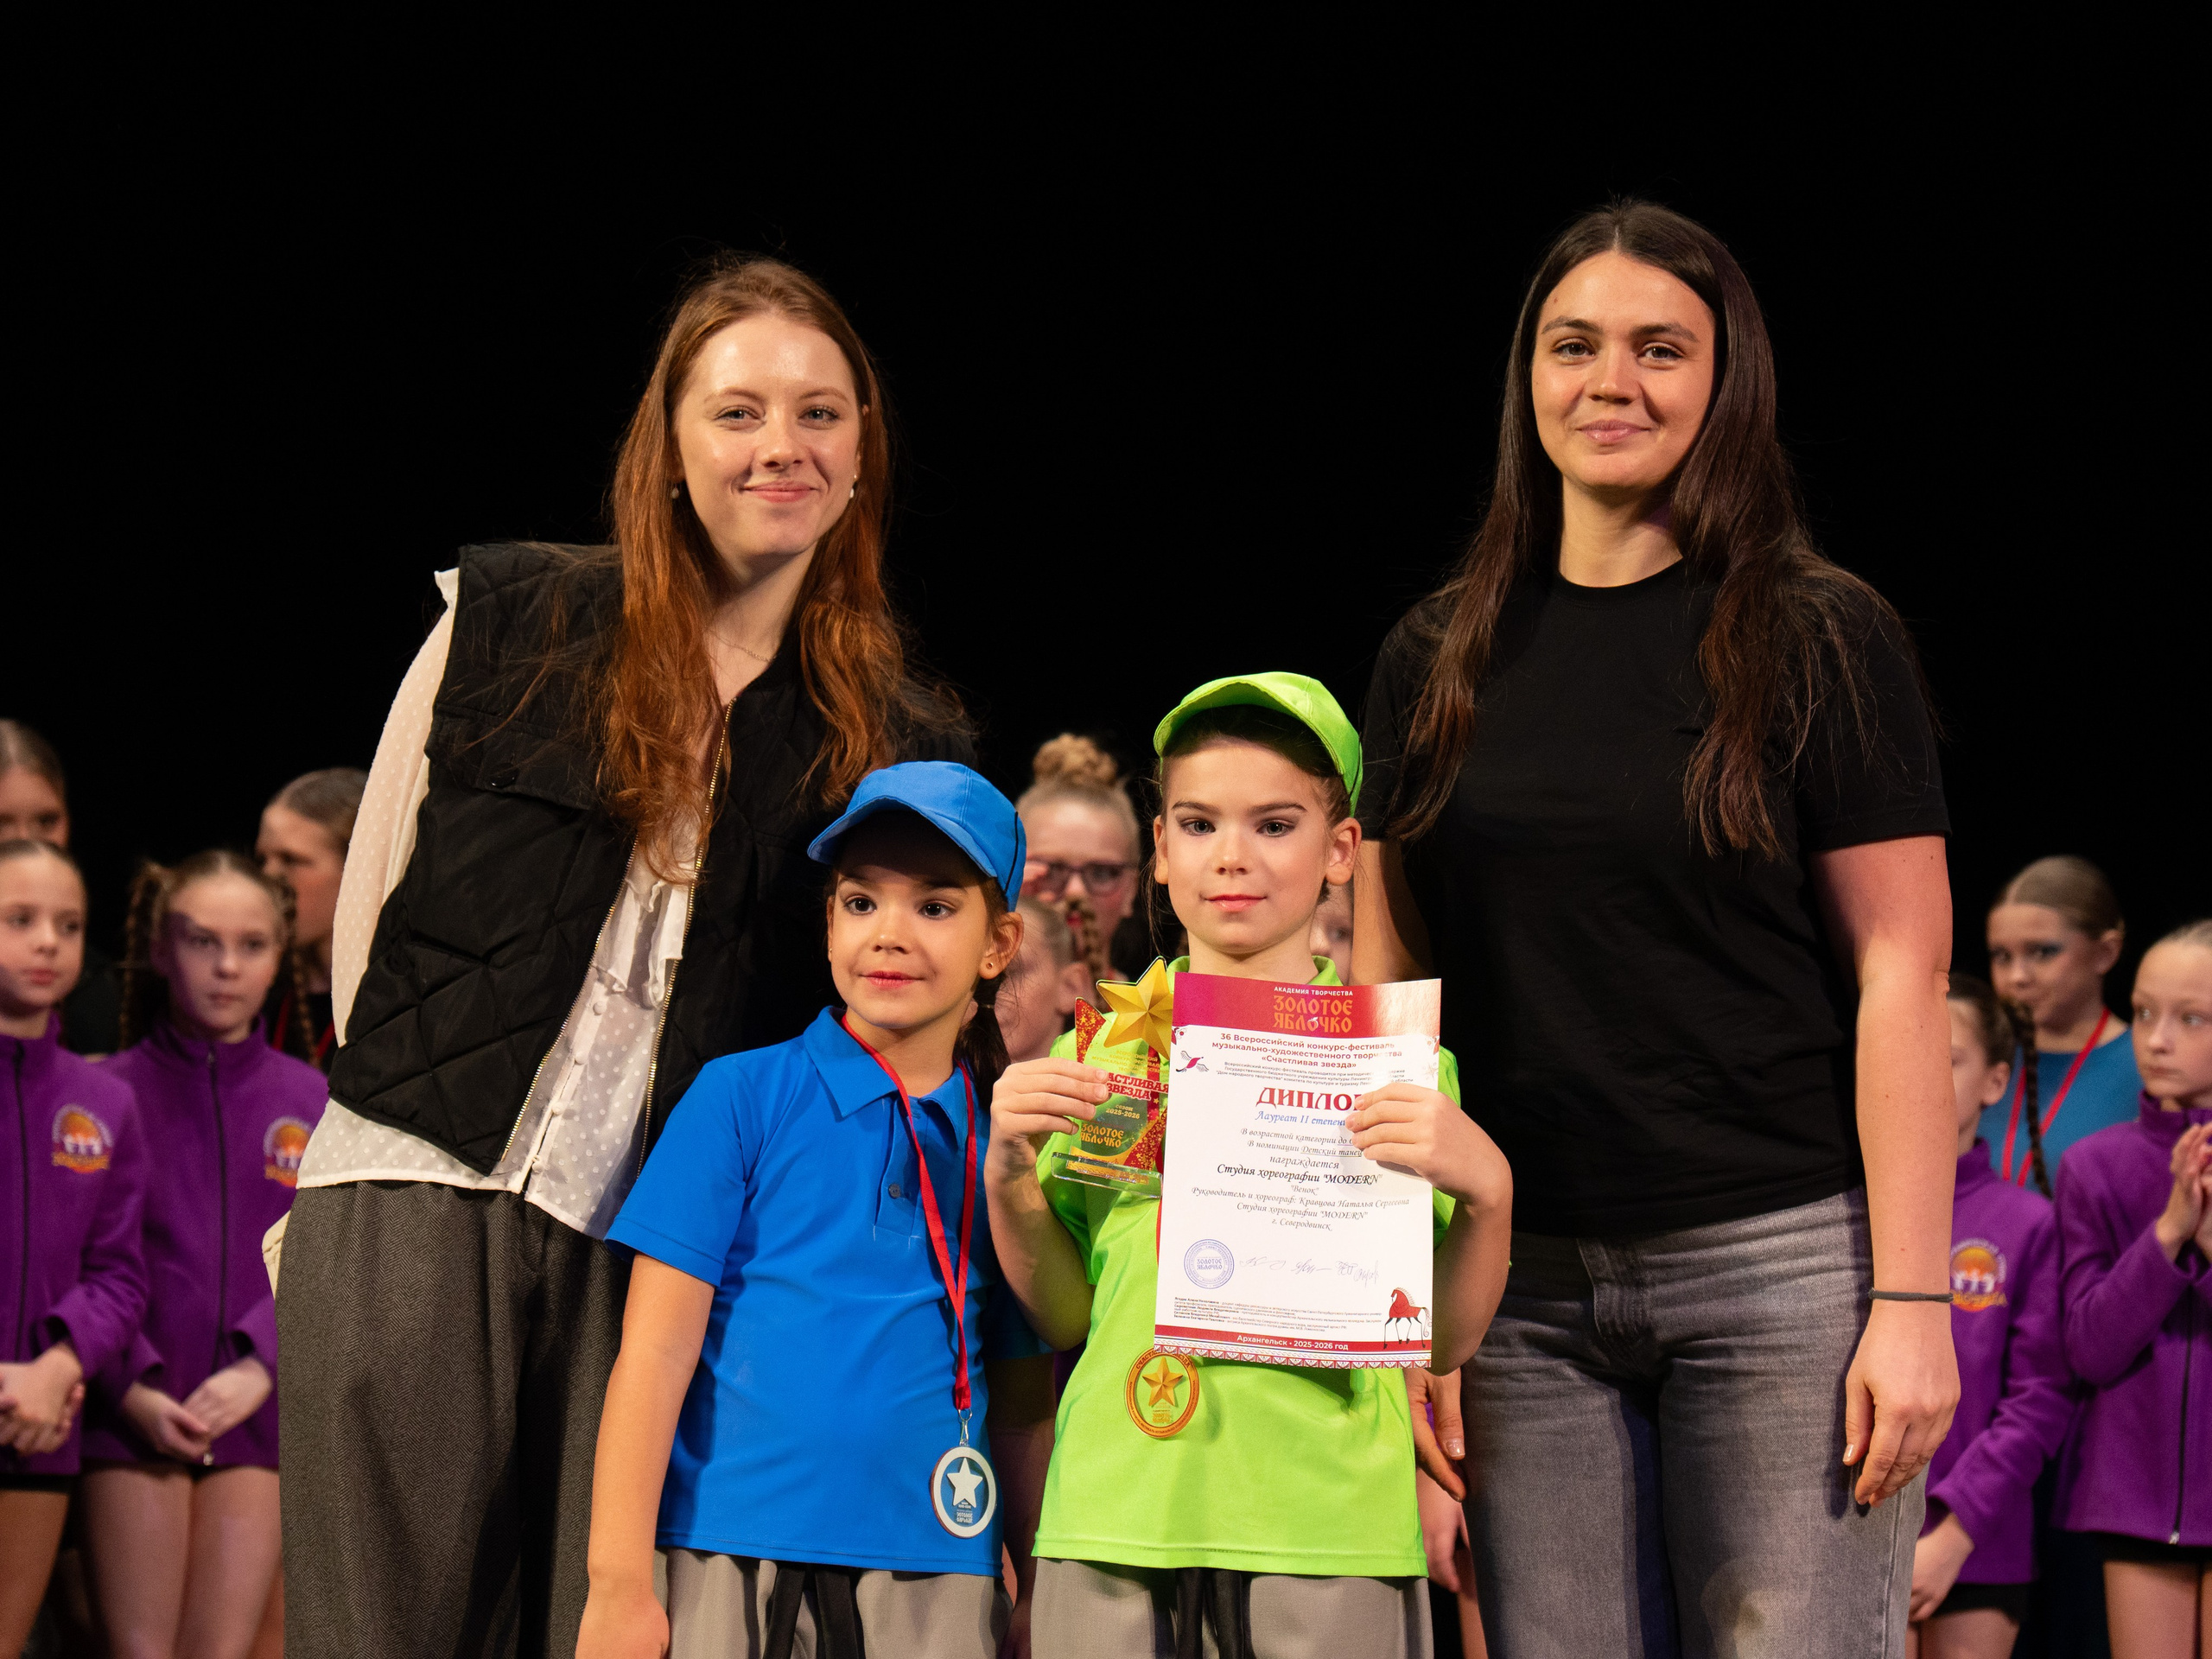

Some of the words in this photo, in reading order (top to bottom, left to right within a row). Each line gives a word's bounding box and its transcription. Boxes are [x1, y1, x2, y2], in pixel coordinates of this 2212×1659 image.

[1274, 986, 1309, 995] АКАДЕМИЯ
[1273, 1012, 1353, 1033] ЯБЛОЧКО
[1211, 1042, 1351, 1059] музыкально-художественного
[1234, 1034, 1305, 1048] Всероссийский
[1307, 1042, 1395, 1052] конкурс-фестиваль
[1262, 1055, 1319, 1066] «Счастливая
[1106, 1082, 1151, 1100] ЗВЕЗДА
[1105, 1108, 1141, 1120] 2025-2026
[1255, 1110, 1297, 1125] Лауреат
[1249, 1128, 1294, 1140] возрастной
[1295, 1133, 1337, 1145] категории
[1338, 1136, 1347, 1145] до
[1255, 1141, 1300, 1153] номинации
[1300, 1145, 1337, 1156] Детский
[1269, 1155, 1340, 1169] награждается
[1217, 1163, 1255, 1177] Студия
[1257, 1169, 1320, 1184] хореографии
[1323, 1173, 1382, 1186] "MODERN"
[1191, 1186, 1246, 1198] Руководитель
[1255, 1193, 1297, 1205] хореограф:
[1299, 1197, 1336, 1208] Кравцова
[1337, 1199, 1373, 1208] Наталья
[1375, 1198, 1409, 1210] Сергеевна
[1236, 1202, 1268, 1213] Студия
[1268, 1206, 1318, 1218] хореографии
[1280, 1217, 1333, 1232] Северодвинск
[1236, 1334, 1287, 1346] Архангельск
[1294, 1340, 1333, 1349] 2025-2026
